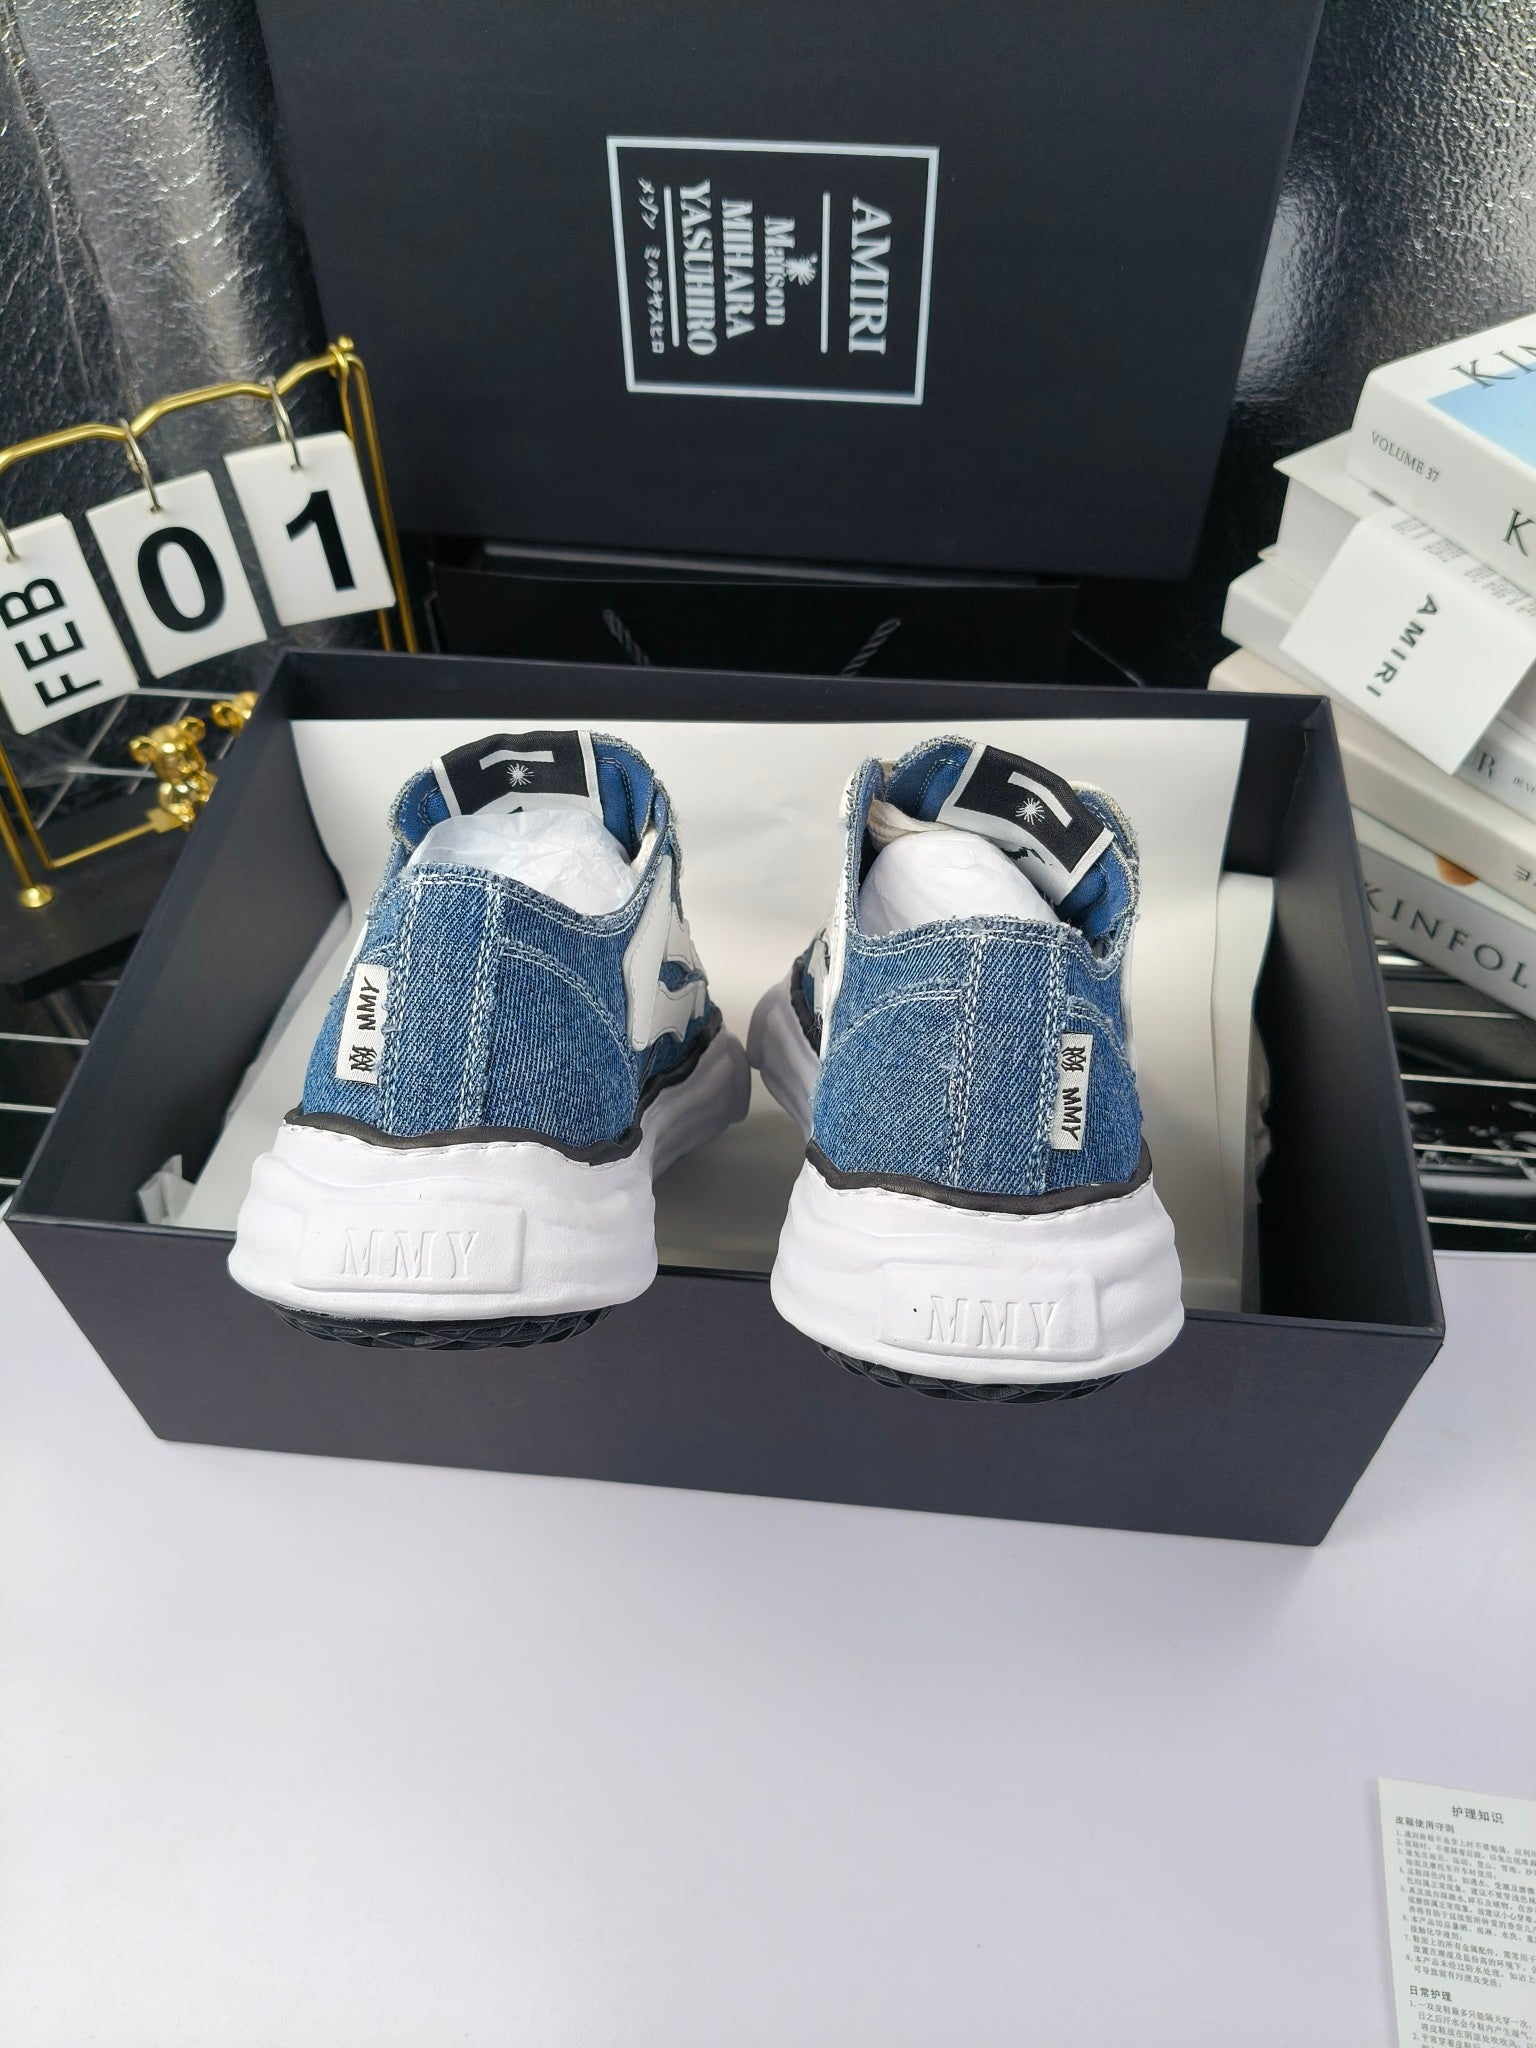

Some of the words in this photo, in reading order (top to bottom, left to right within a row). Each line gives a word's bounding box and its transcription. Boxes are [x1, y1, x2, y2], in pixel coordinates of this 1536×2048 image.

[679, 178, 717, 355] YASUHIRO
[722, 197, 755, 339] MIHARA
[764, 215, 795, 325] Maison
[848, 195, 892, 355] AMIRI
[1370, 431, 1424, 475] VOLUME
[1424, 467, 1440, 484] 37
[0, 577, 103, 708] FEB
[1365, 592, 1440, 698] AMIRI
[340, 1228, 479, 1279] MMY
[927, 1294, 1060, 1349] MMY
[1395, 1815, 1455, 1834] 皮鞋使用守则
[1452, 1806, 1504, 1825] 护理知识
[1409, 1985, 1452, 2002] 日常护理
